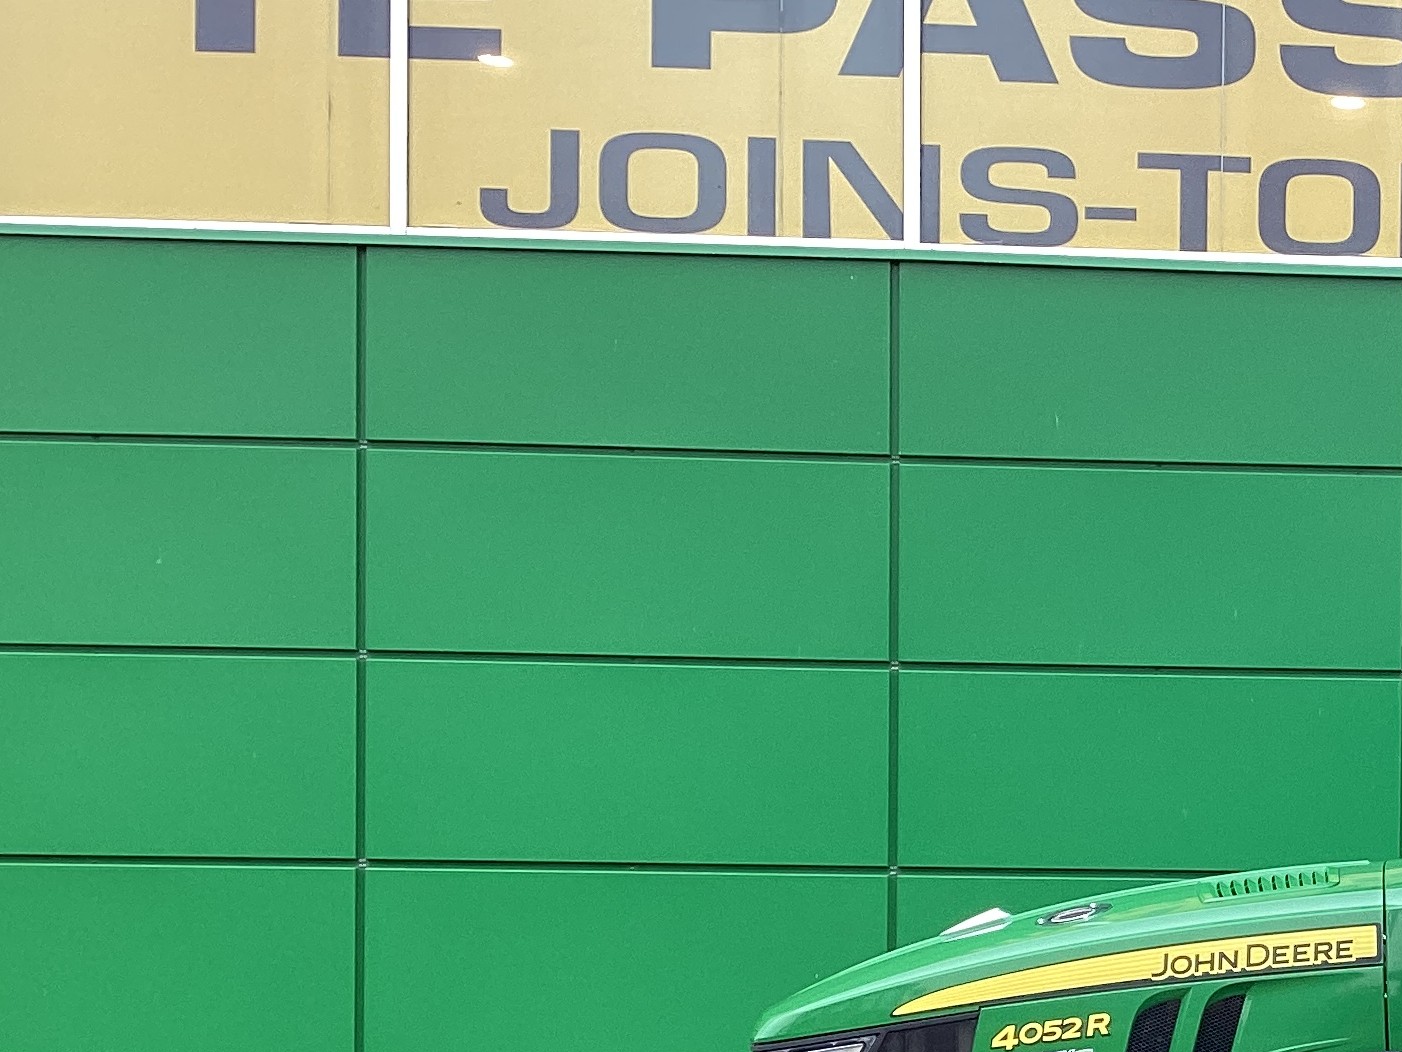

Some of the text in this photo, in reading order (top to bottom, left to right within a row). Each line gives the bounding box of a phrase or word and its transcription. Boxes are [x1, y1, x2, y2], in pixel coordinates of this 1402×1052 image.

[1152, 940, 1354, 978] JOHN DEERE
[990, 1012, 1111, 1051] 4052R
